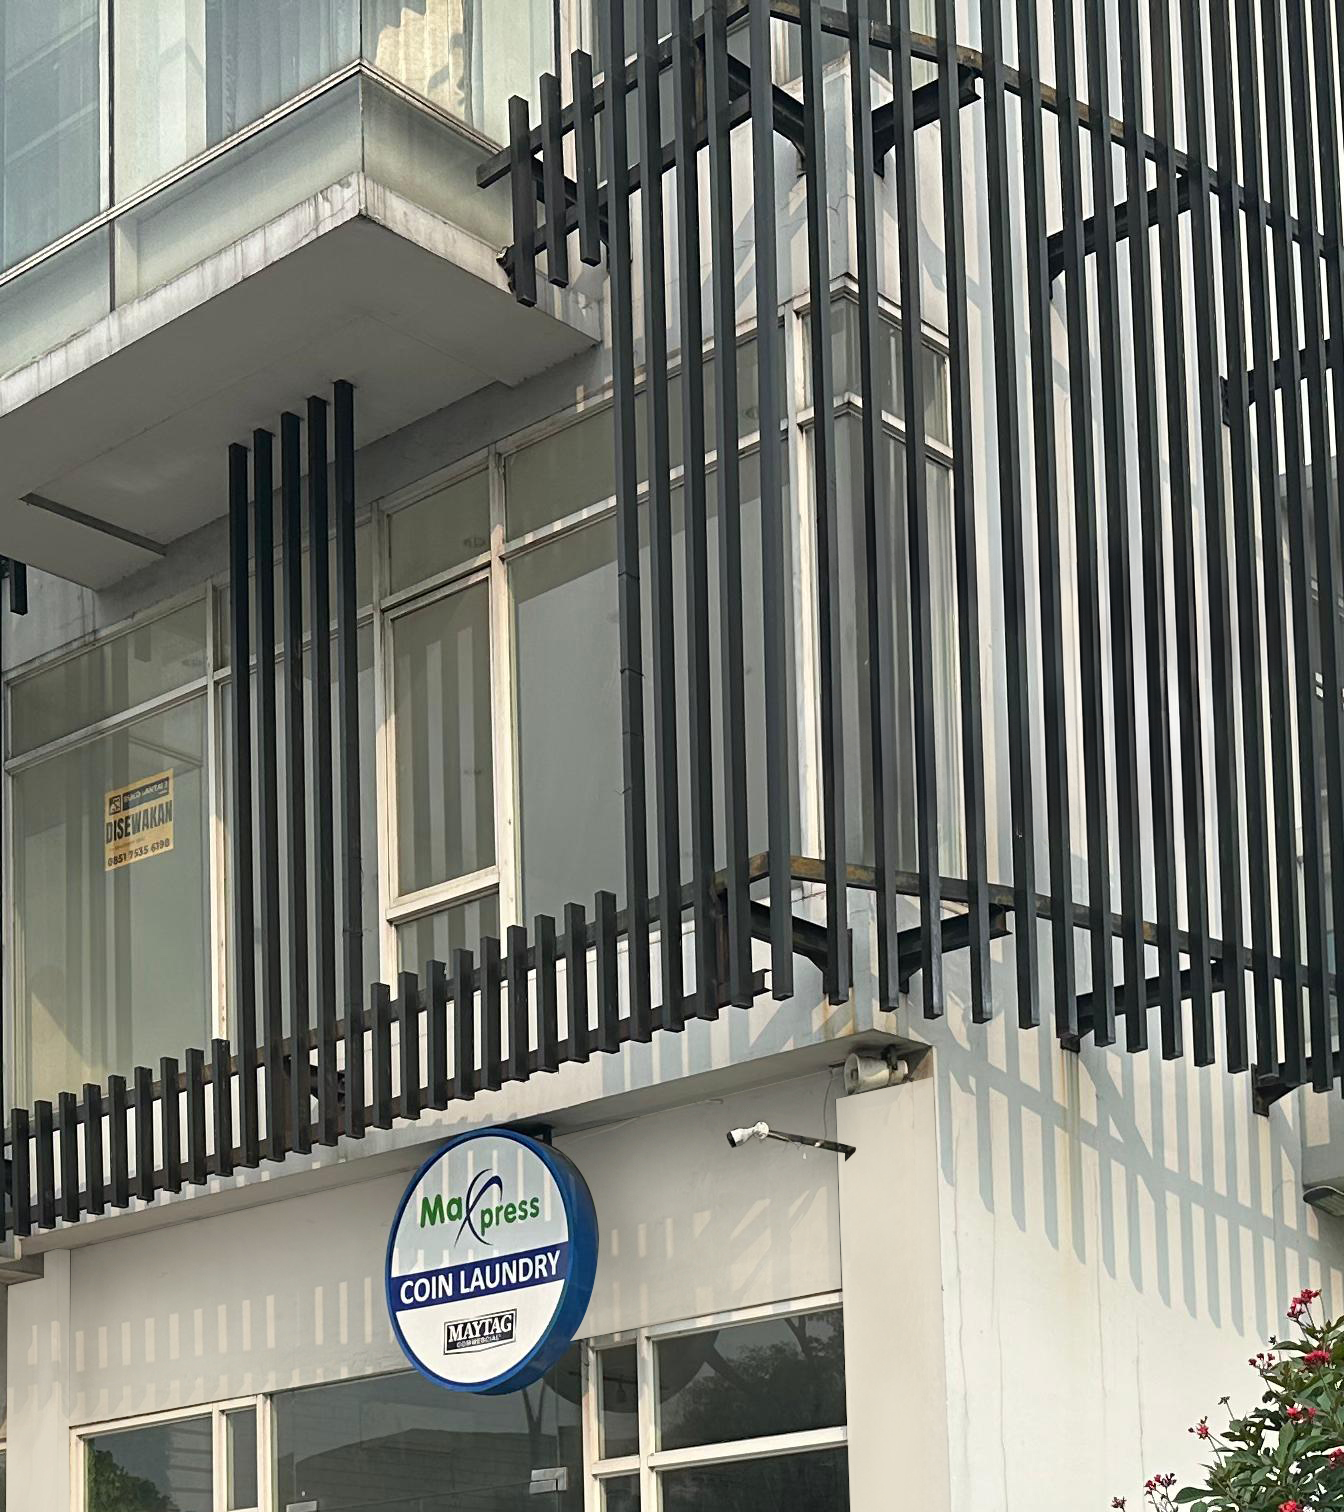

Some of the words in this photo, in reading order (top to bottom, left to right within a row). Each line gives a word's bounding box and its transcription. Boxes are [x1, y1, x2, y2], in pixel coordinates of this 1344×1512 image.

[106, 799, 173, 844] DISEWAKAN
[400, 1272, 453, 1305] COIN
[460, 1250, 561, 1294] LAUNDRY
[448, 1314, 512, 1343] MAYTAG
